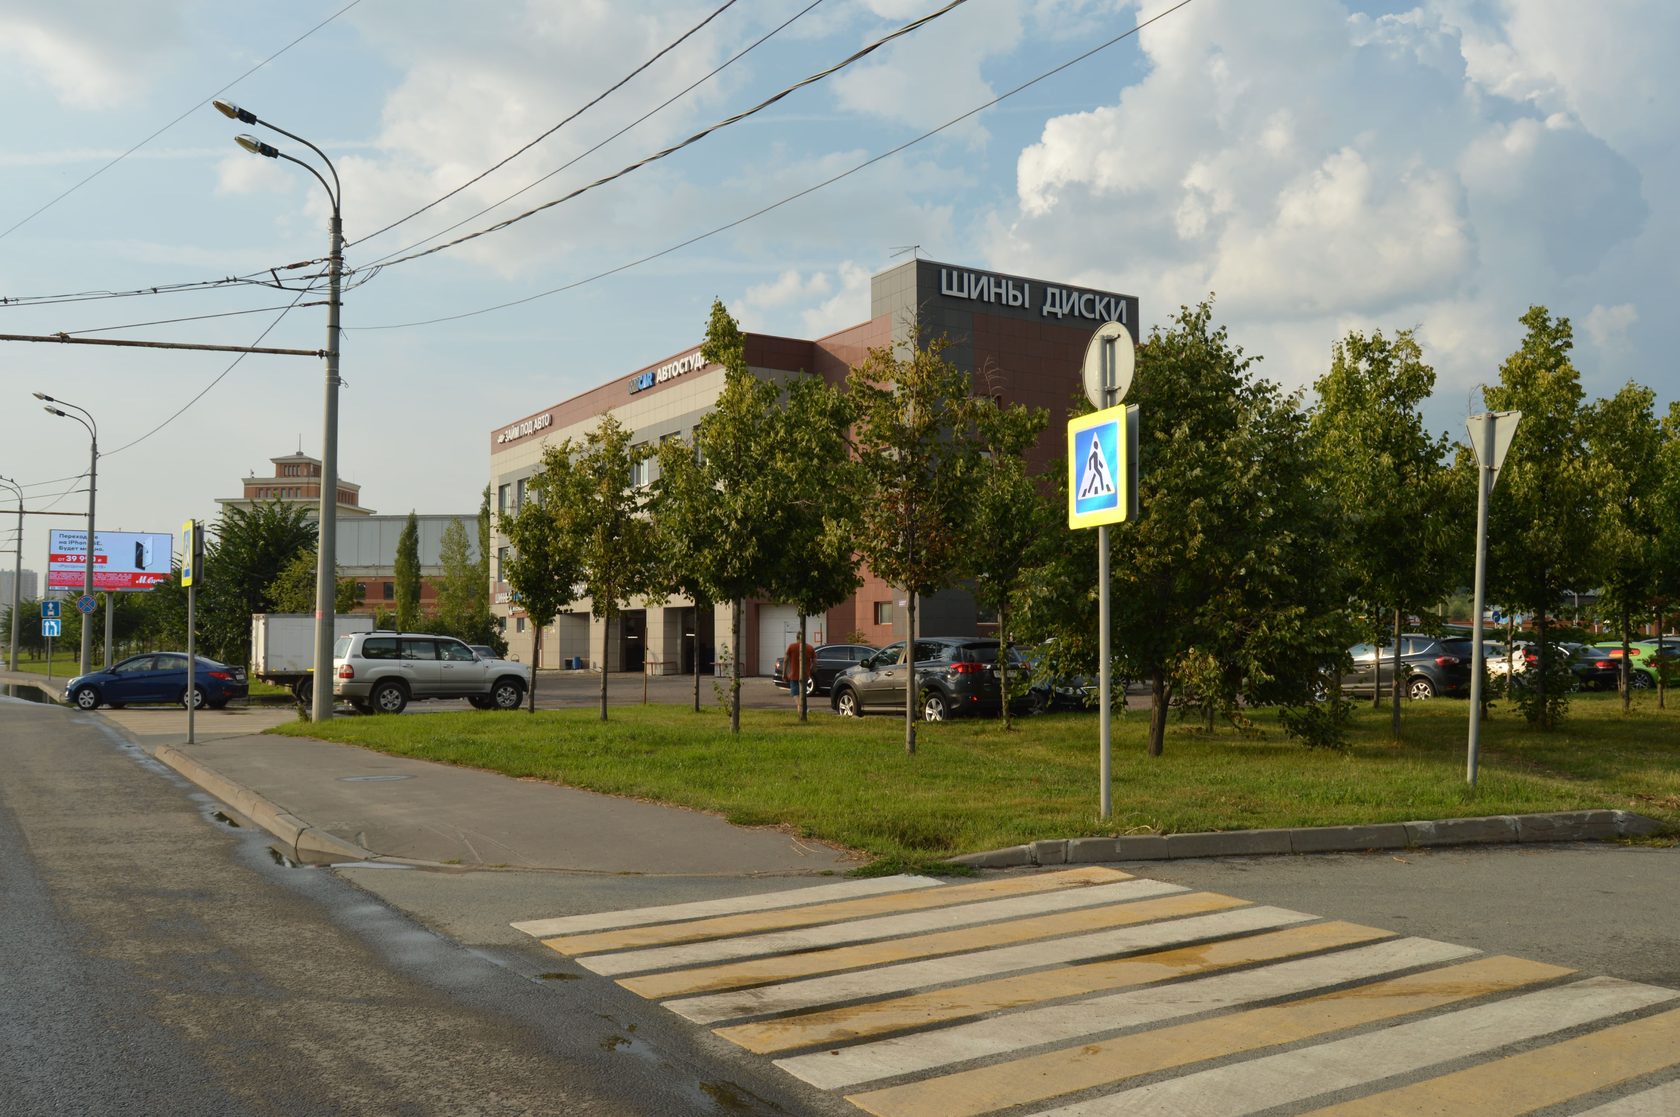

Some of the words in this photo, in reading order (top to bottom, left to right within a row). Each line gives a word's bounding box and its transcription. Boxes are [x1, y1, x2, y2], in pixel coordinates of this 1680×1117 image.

[941, 268, 1030, 309] ШИНЫ
[1042, 286, 1127, 324] ДИСКИ
[519, 420, 533, 437] ПОД
[533, 413, 550, 431] АВТО
